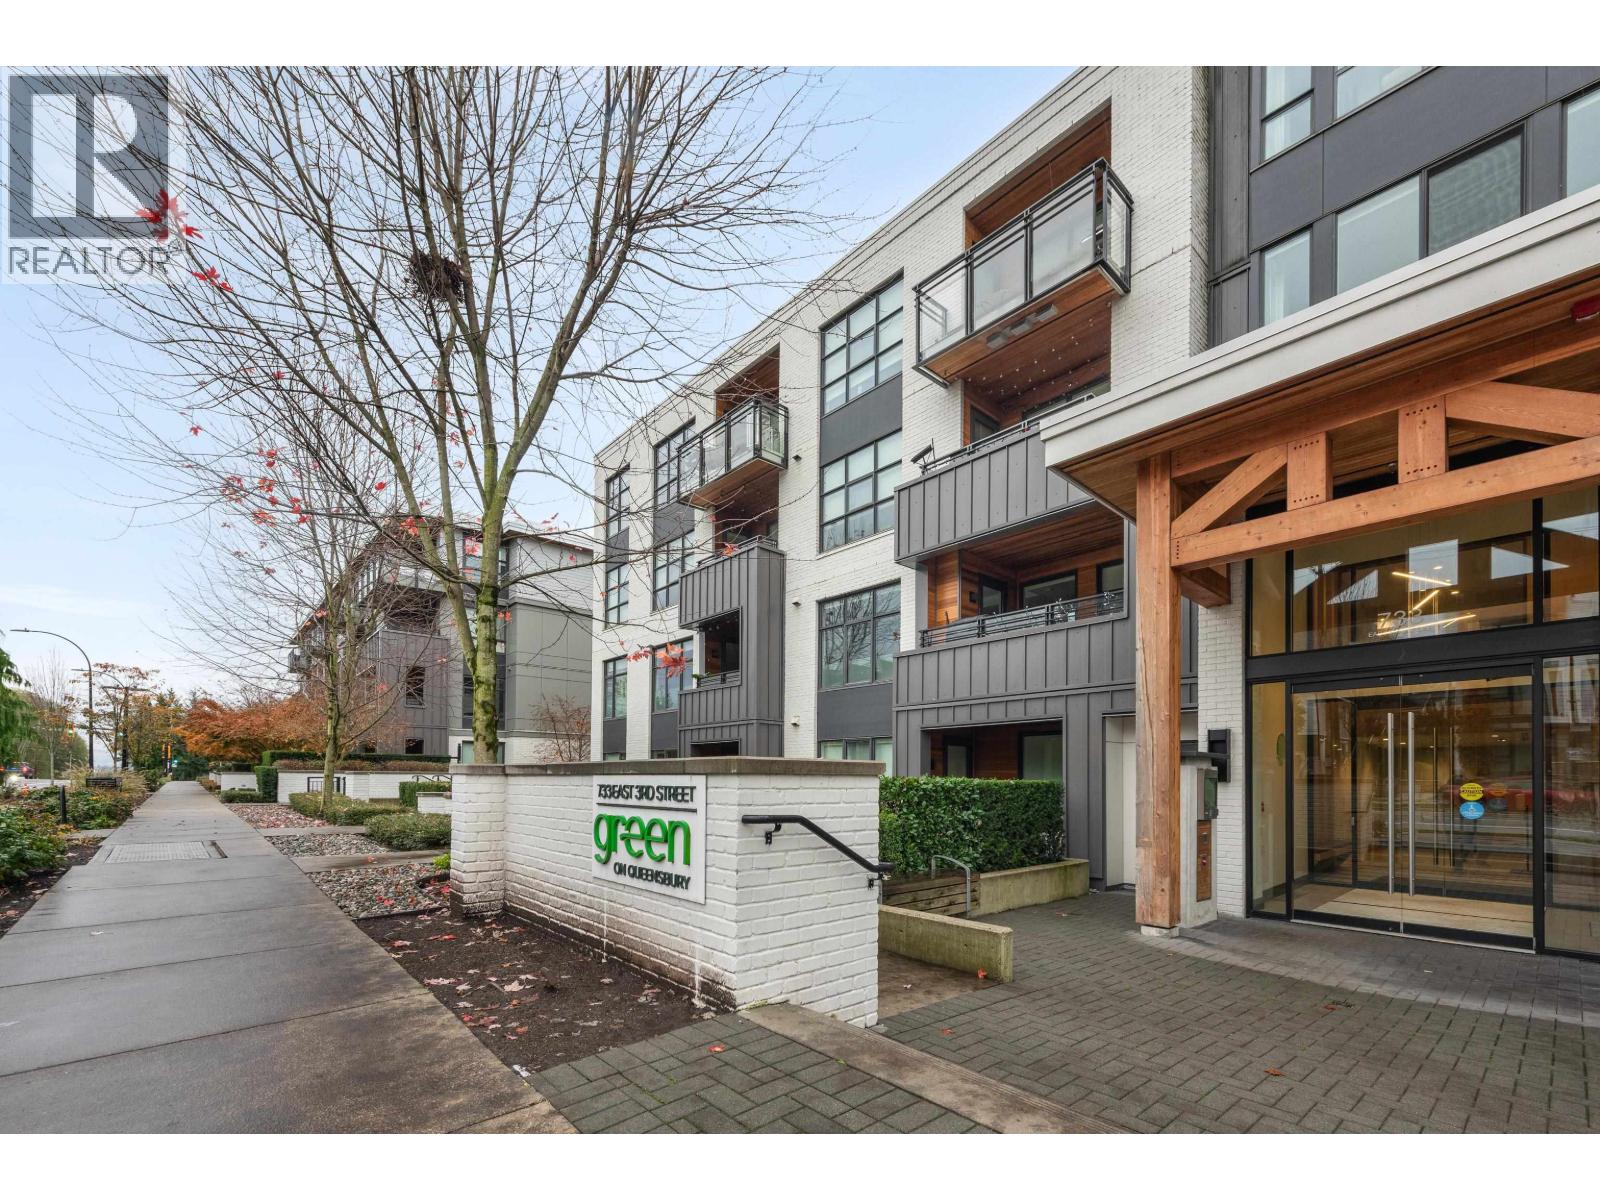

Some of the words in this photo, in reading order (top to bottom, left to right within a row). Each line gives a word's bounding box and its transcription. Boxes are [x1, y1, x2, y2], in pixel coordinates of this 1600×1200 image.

[635, 785, 655, 801] 3RD
[656, 785, 696, 802] STREET
[594, 813, 691, 866] green
[613, 862, 626, 876] ON
[628, 864, 691, 890] QUEENSBURY
